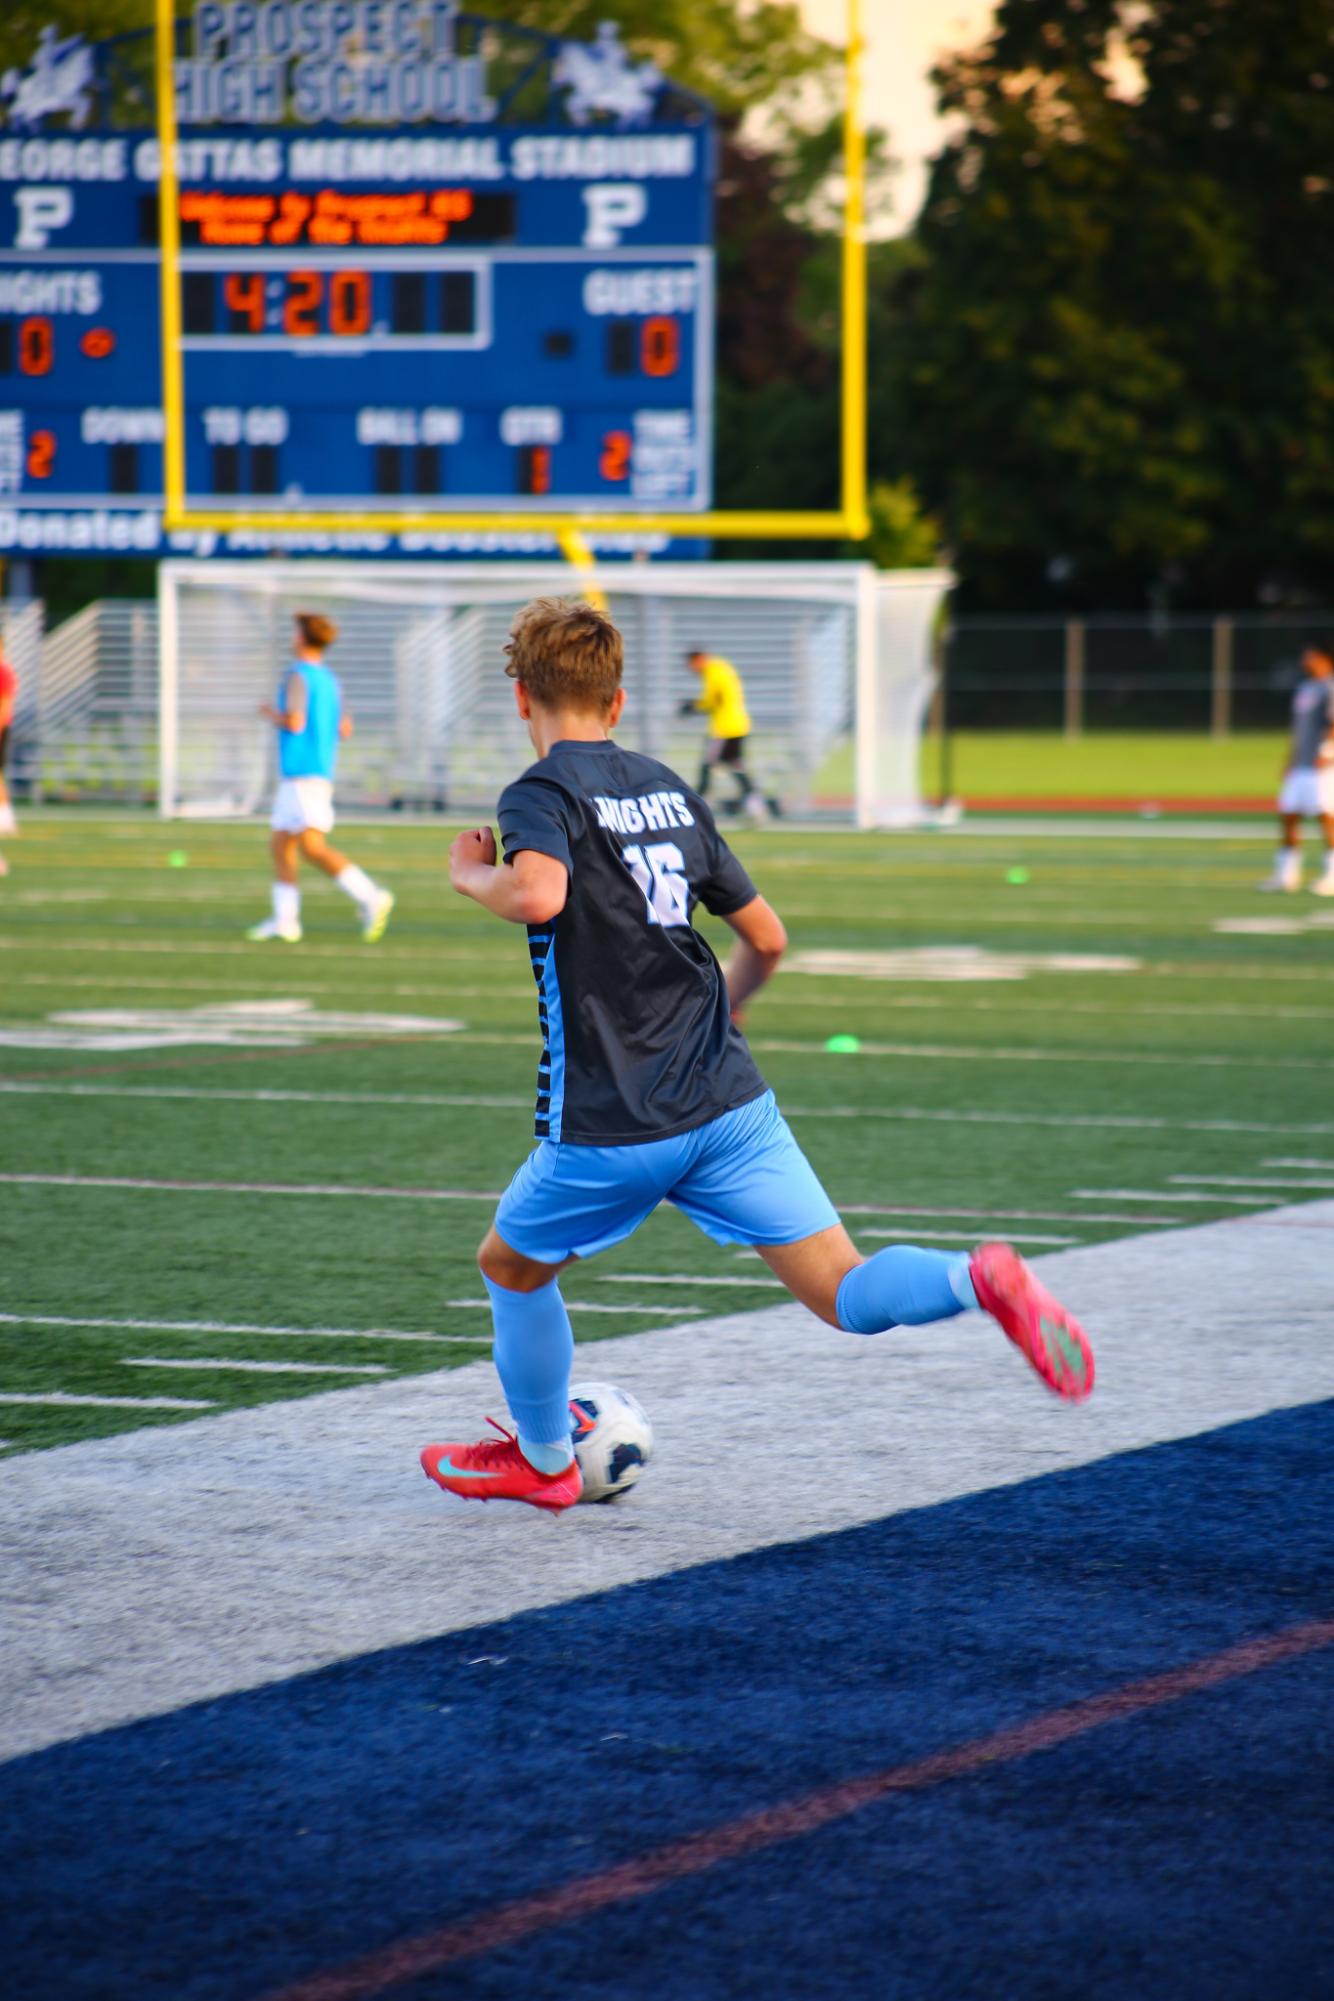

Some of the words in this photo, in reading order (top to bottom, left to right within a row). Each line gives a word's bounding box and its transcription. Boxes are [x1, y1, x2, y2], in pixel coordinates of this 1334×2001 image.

[194, 1, 459, 57] PROSPECT
[292, 57, 497, 123] SCHOOL
[289, 137, 503, 181] MEMORIAL
[511, 135, 694, 180] STADIUM
[13, 186, 74, 248] P
[583, 184, 648, 248] P
[224, 268, 372, 336] 4:20
[583, 269, 695, 316] GUEST
[19, 315, 54, 377] 0
[640, 316, 680, 377] 0
[27, 430, 56, 478] 2
[600, 431, 632, 480] 2
[622, 842, 690, 928] 16
